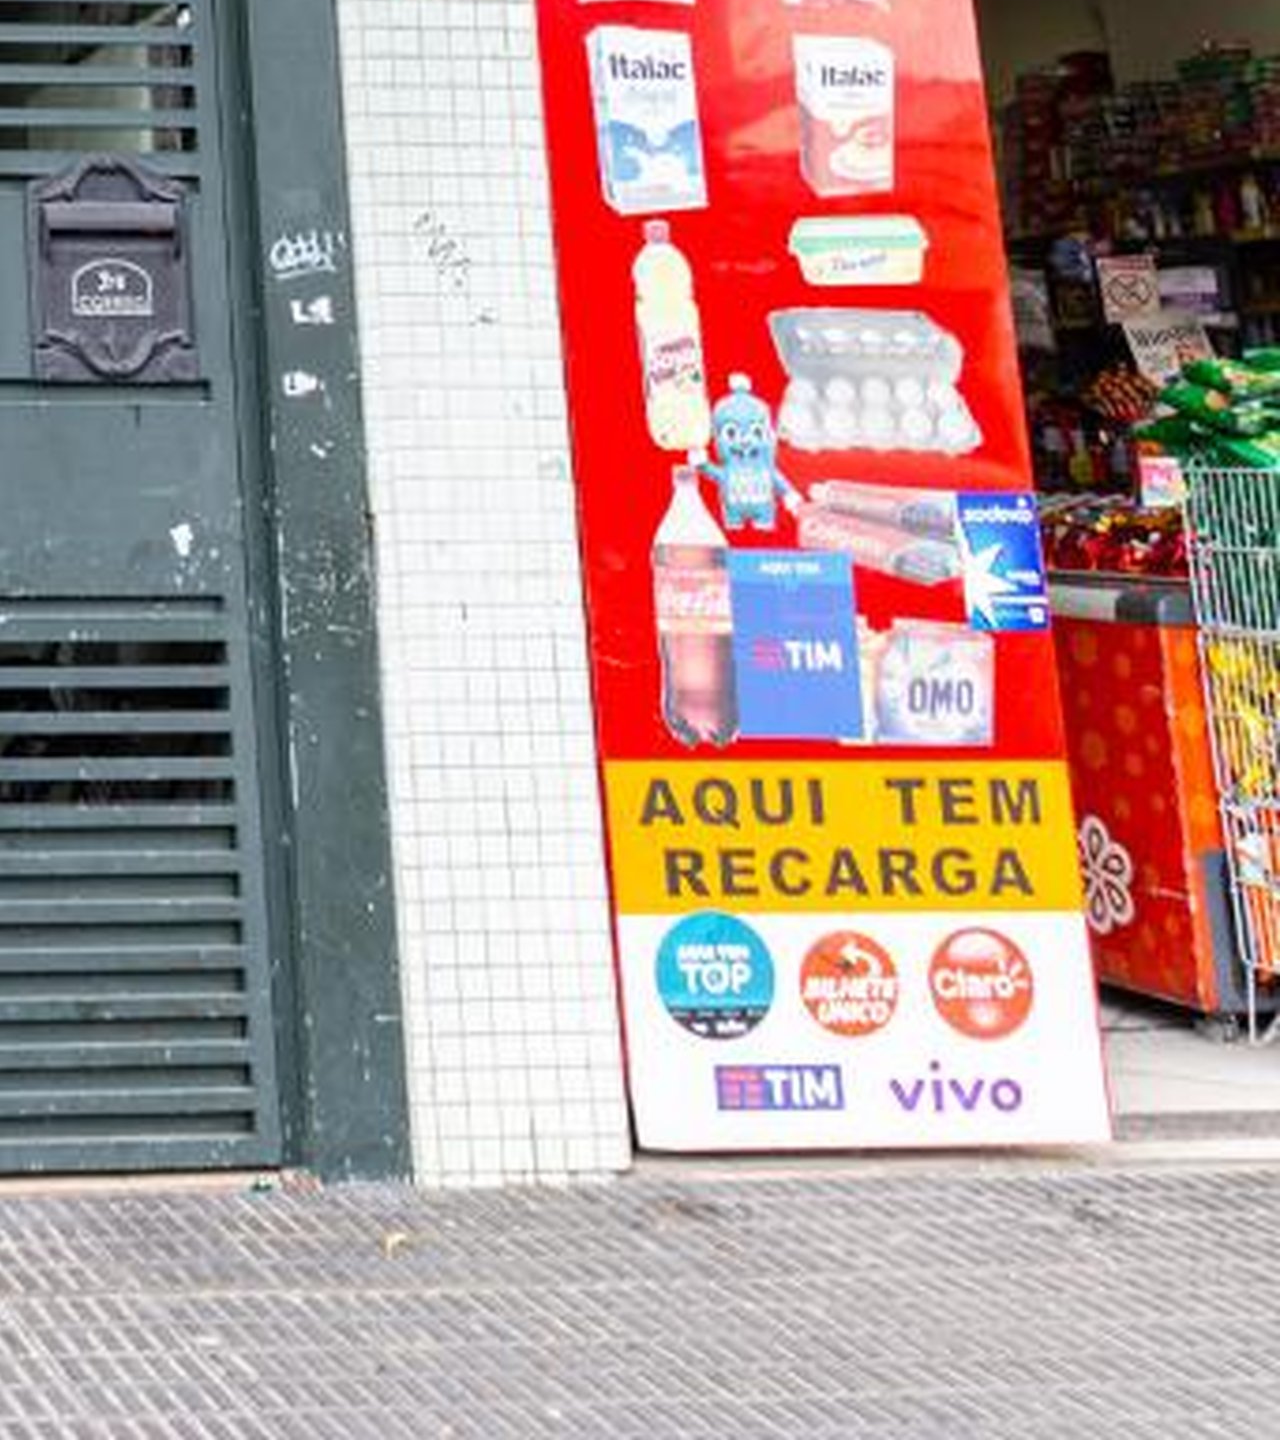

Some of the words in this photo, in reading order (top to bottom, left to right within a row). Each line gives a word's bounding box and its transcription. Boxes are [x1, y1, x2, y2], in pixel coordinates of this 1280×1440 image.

[608, 52, 687, 81] Italac
[820, 64, 887, 88] Italac
[784, 639, 844, 673] TIM
[908, 677, 974, 719] OMO
[639, 777, 825, 829] AQUI
[885, 777, 1042, 826] TEM
[662, 846, 1036, 898] RECARGA
[680, 961, 752, 995] TOP
[935, 966, 1017, 1000] Claro
[764, 1068, 839, 1108] TIM
[889, 1060, 1024, 1112] vivo
